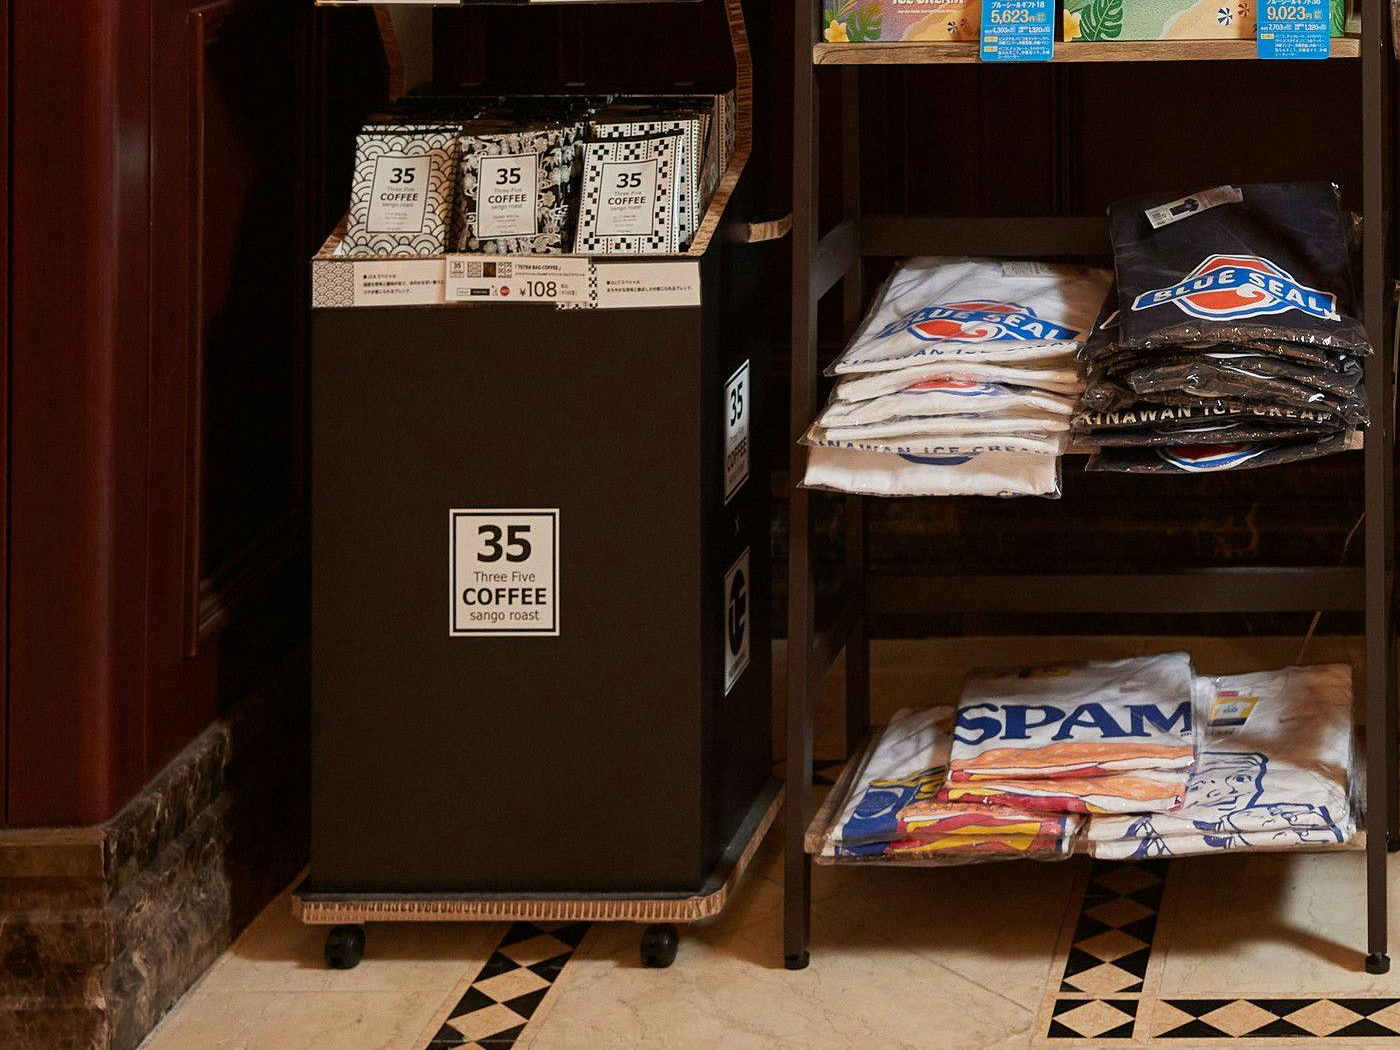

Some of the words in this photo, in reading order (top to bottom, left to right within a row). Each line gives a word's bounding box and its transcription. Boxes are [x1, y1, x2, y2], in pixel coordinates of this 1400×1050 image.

[991, 10, 1035, 23] 5,623円
[1267, 6, 1312, 20] 9,023円
[389, 168, 415, 184] 35
[495, 168, 521, 184] 35
[616, 173, 641, 188] 35
[380, 192, 418, 202] COFFEE
[488, 193, 527, 204] COFFEE
[608, 195, 646, 206] COFFEE
[519, 281, 557, 298] ¥108
[1153, 270, 1236, 301] BLUE
[1249, 272, 1327, 312] SEAL
[730, 382, 743, 426] 35
[476, 524, 532, 563] 35
[474, 571, 507, 582] Three
[512, 572, 535, 582] Five
[462, 587, 547, 606] COFFEE
[470, 611, 505, 623] sango
[510, 610, 539, 621] roast
[955, 701, 1192, 745] SPAM
